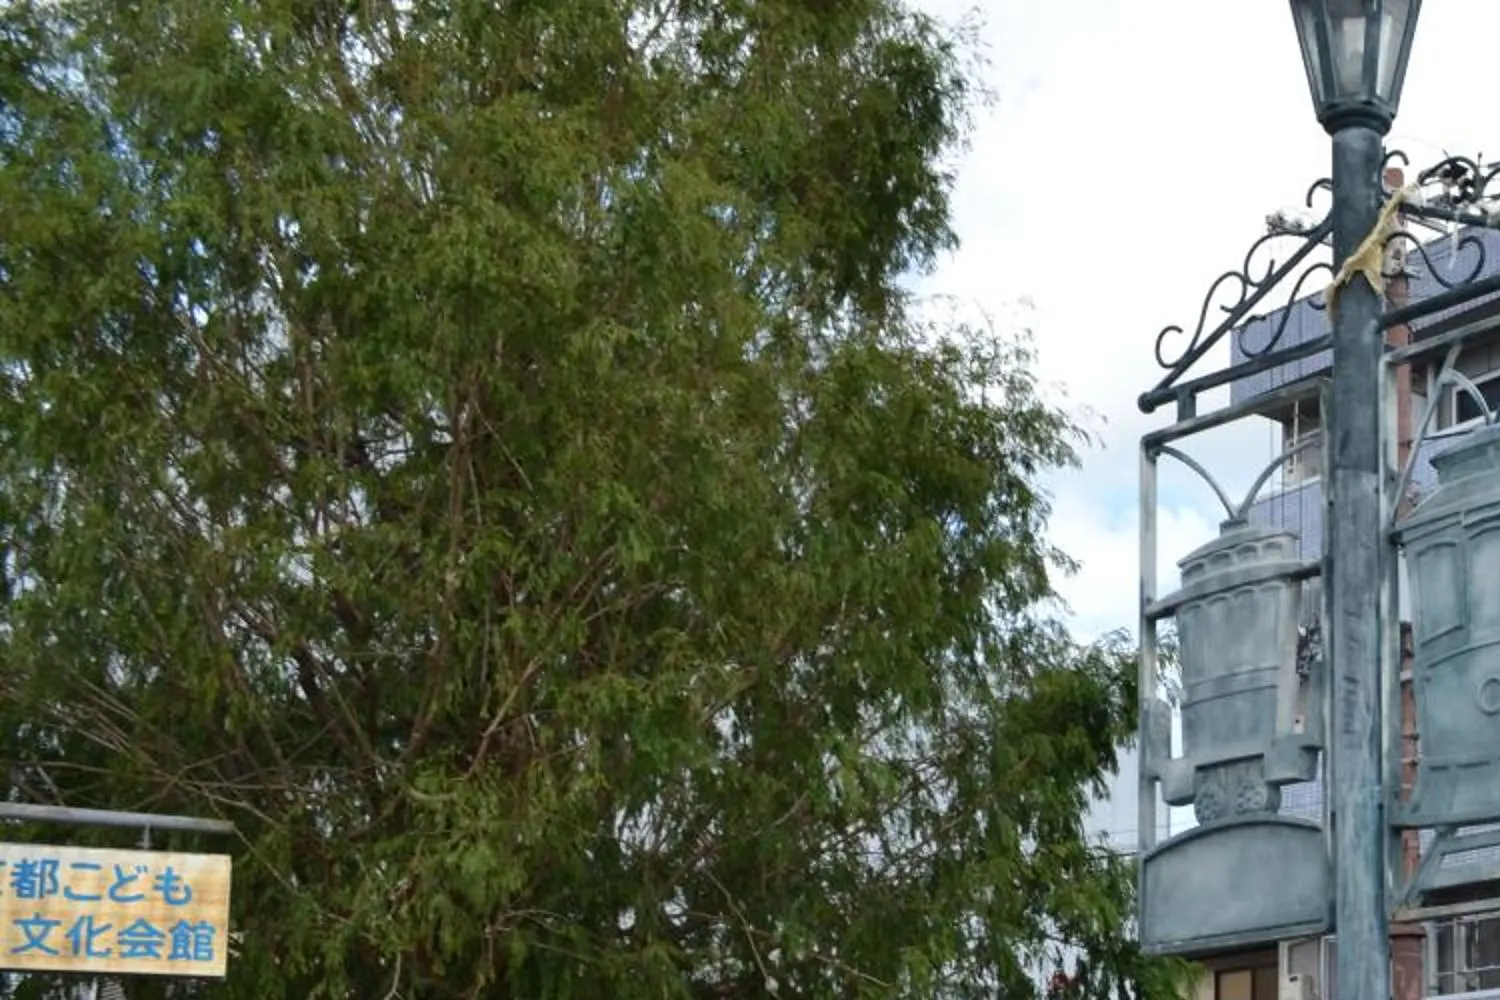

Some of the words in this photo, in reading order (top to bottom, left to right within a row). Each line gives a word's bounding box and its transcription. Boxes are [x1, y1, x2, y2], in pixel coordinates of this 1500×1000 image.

[0, 857, 193, 906] 都こども
[10, 911, 217, 962] 文化会館
